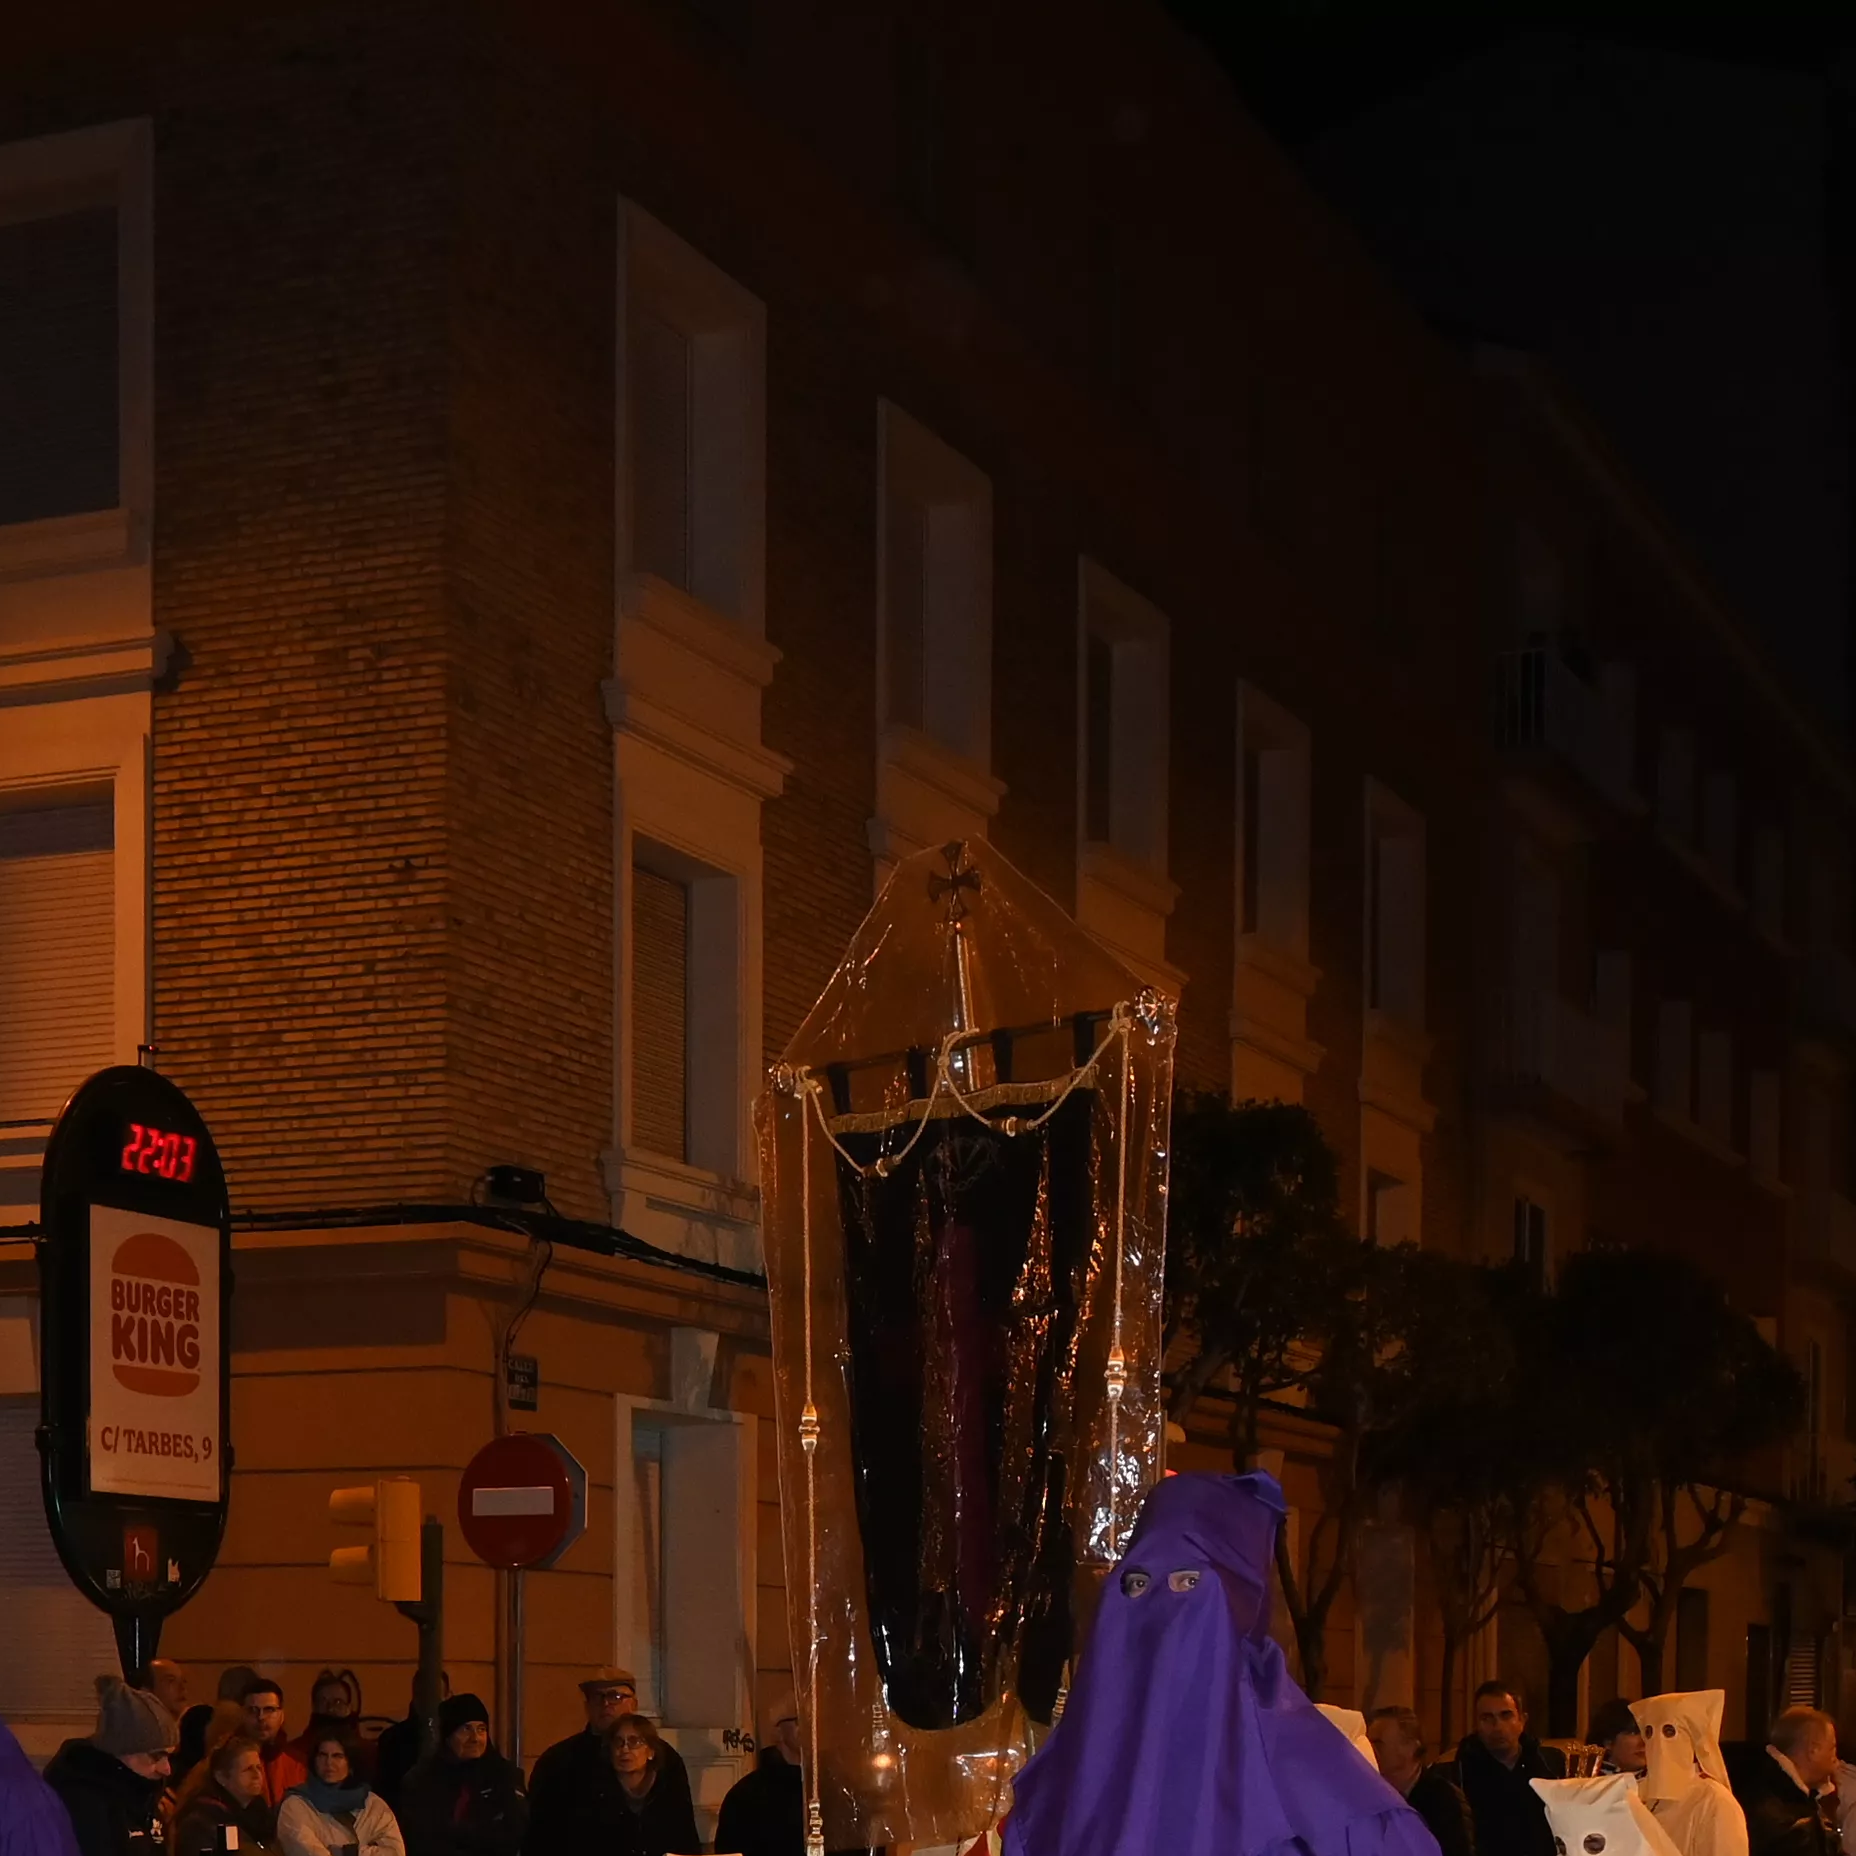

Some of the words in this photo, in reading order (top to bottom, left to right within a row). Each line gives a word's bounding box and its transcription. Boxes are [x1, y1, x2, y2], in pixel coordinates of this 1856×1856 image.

[121, 1122, 198, 1183] 22:03
[111, 1278, 200, 1323] BURGER
[112, 1313, 200, 1370] KING
[100, 1425, 120, 1454] C/
[123, 1429, 199, 1464] TARBES,
[202, 1436, 213, 1460] 9
